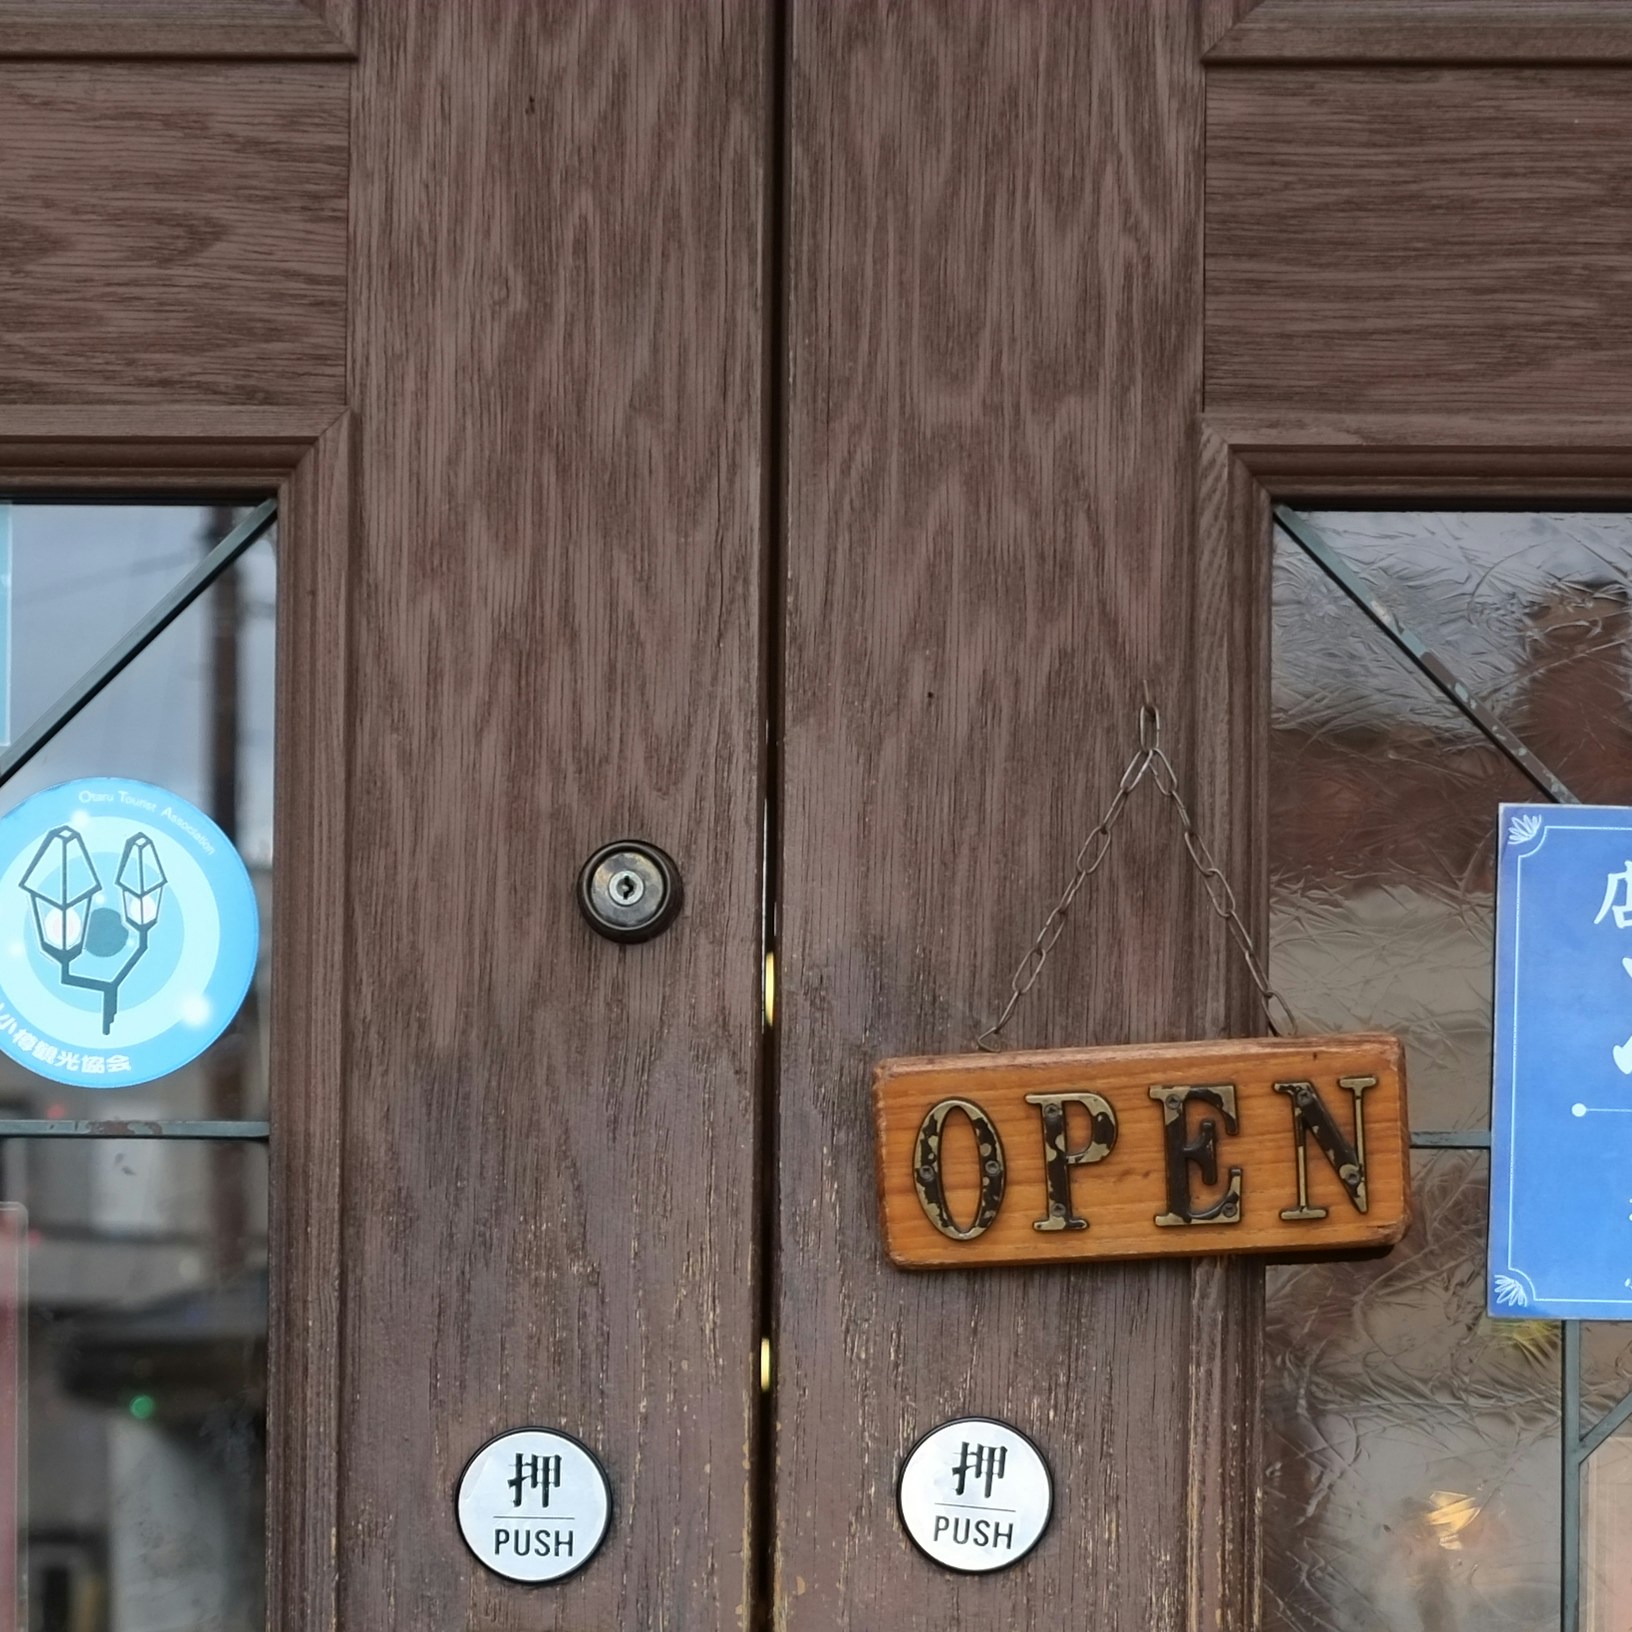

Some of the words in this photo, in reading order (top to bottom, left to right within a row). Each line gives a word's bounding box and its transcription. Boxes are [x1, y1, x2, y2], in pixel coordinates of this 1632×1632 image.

[78, 790, 114, 804] Otaru
[118, 790, 157, 812] Tourist
[161, 807, 216, 856] Association
[912, 1075, 1380, 1242] OPEN
[507, 1451, 563, 1509] 押
[951, 1439, 1008, 1498] 押
[492, 1527, 576, 1559] PUSH
[932, 1513, 1015, 1550] PUSH
